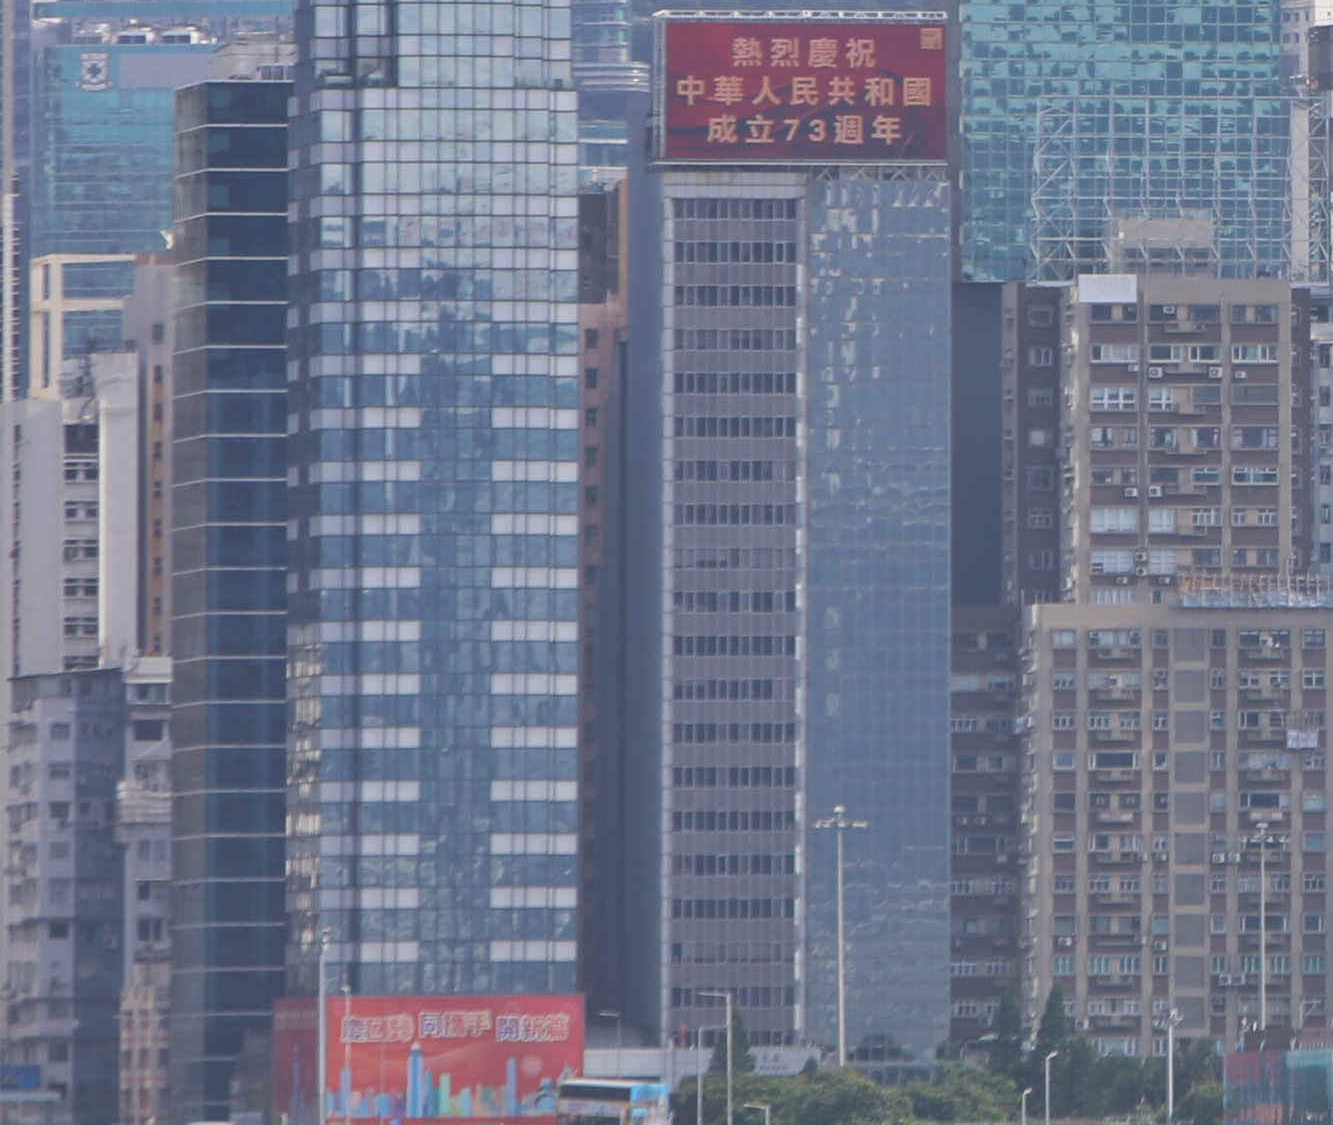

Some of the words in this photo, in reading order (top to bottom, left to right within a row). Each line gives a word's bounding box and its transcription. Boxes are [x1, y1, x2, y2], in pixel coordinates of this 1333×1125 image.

[731, 36, 877, 69] 熱烈慶祝
[675, 75, 932, 107] 中華人民共和國
[706, 114, 902, 145] 成立73週年
